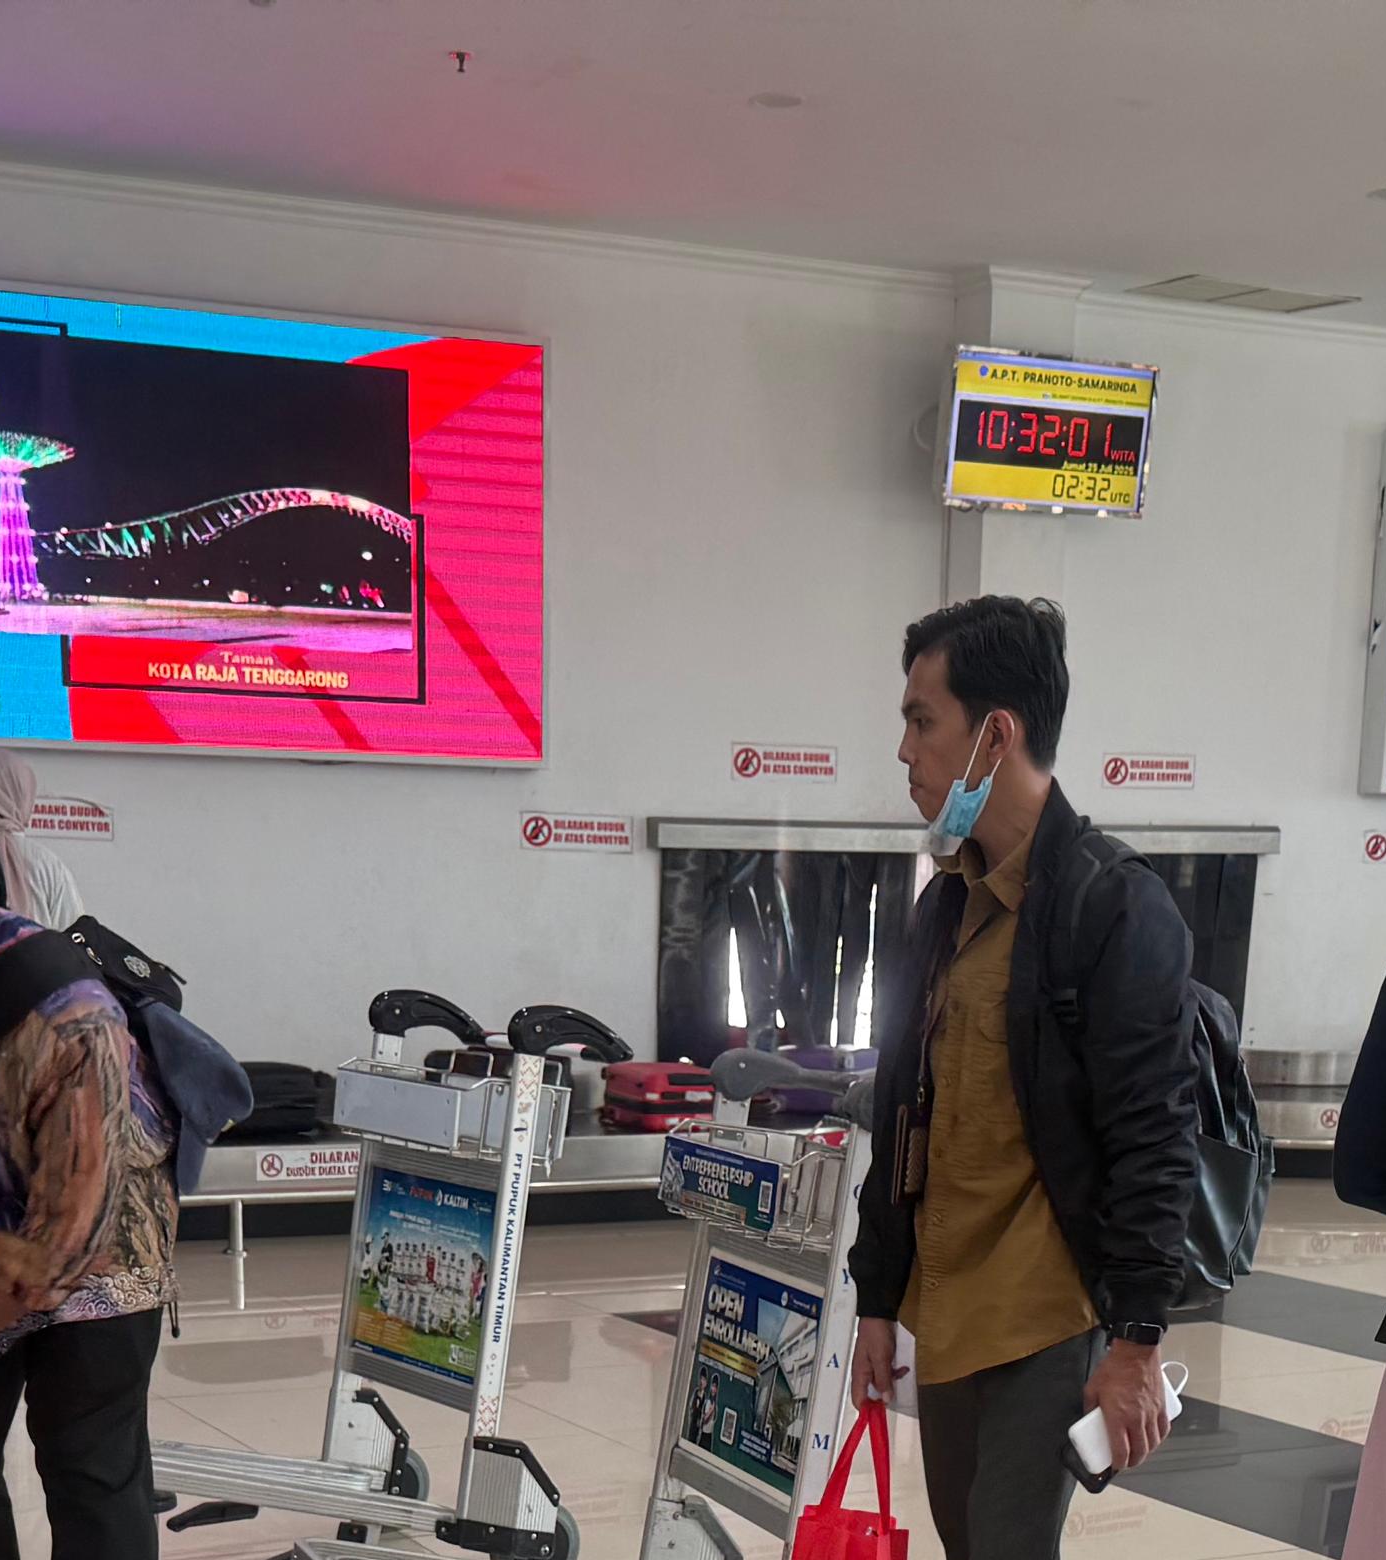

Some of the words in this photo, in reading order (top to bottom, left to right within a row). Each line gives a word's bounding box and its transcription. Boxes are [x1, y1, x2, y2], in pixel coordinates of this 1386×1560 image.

[991, 368, 1020, 383] A.P.T.
[1110, 449, 1136, 463] WITA
[1052, 474, 1111, 502] 02:32
[1110, 491, 1131, 504] UTC
[219, 650, 274, 666] Taman
[147, 662, 193, 681] KOTA
[195, 664, 240, 684] RAJA
[241, 666, 350, 689] TENGGARONG
[31, 818, 56, 830] ATAS
[57, 819, 111, 833] CONVEYOR
[310, 1150, 359, 1164] DILARAN
[514, 1153, 524, 1170] PT
[507, 1173, 521, 1217] PUPUK
[698, 1176, 730, 1200] SCHOOL
[443, 1193, 469, 1210] KALTIM
[495, 1218, 516, 1301] KALIMANTAN
[708, 1283, 745, 1323] OPEN
[491, 1303, 505, 1344] TIMUR
